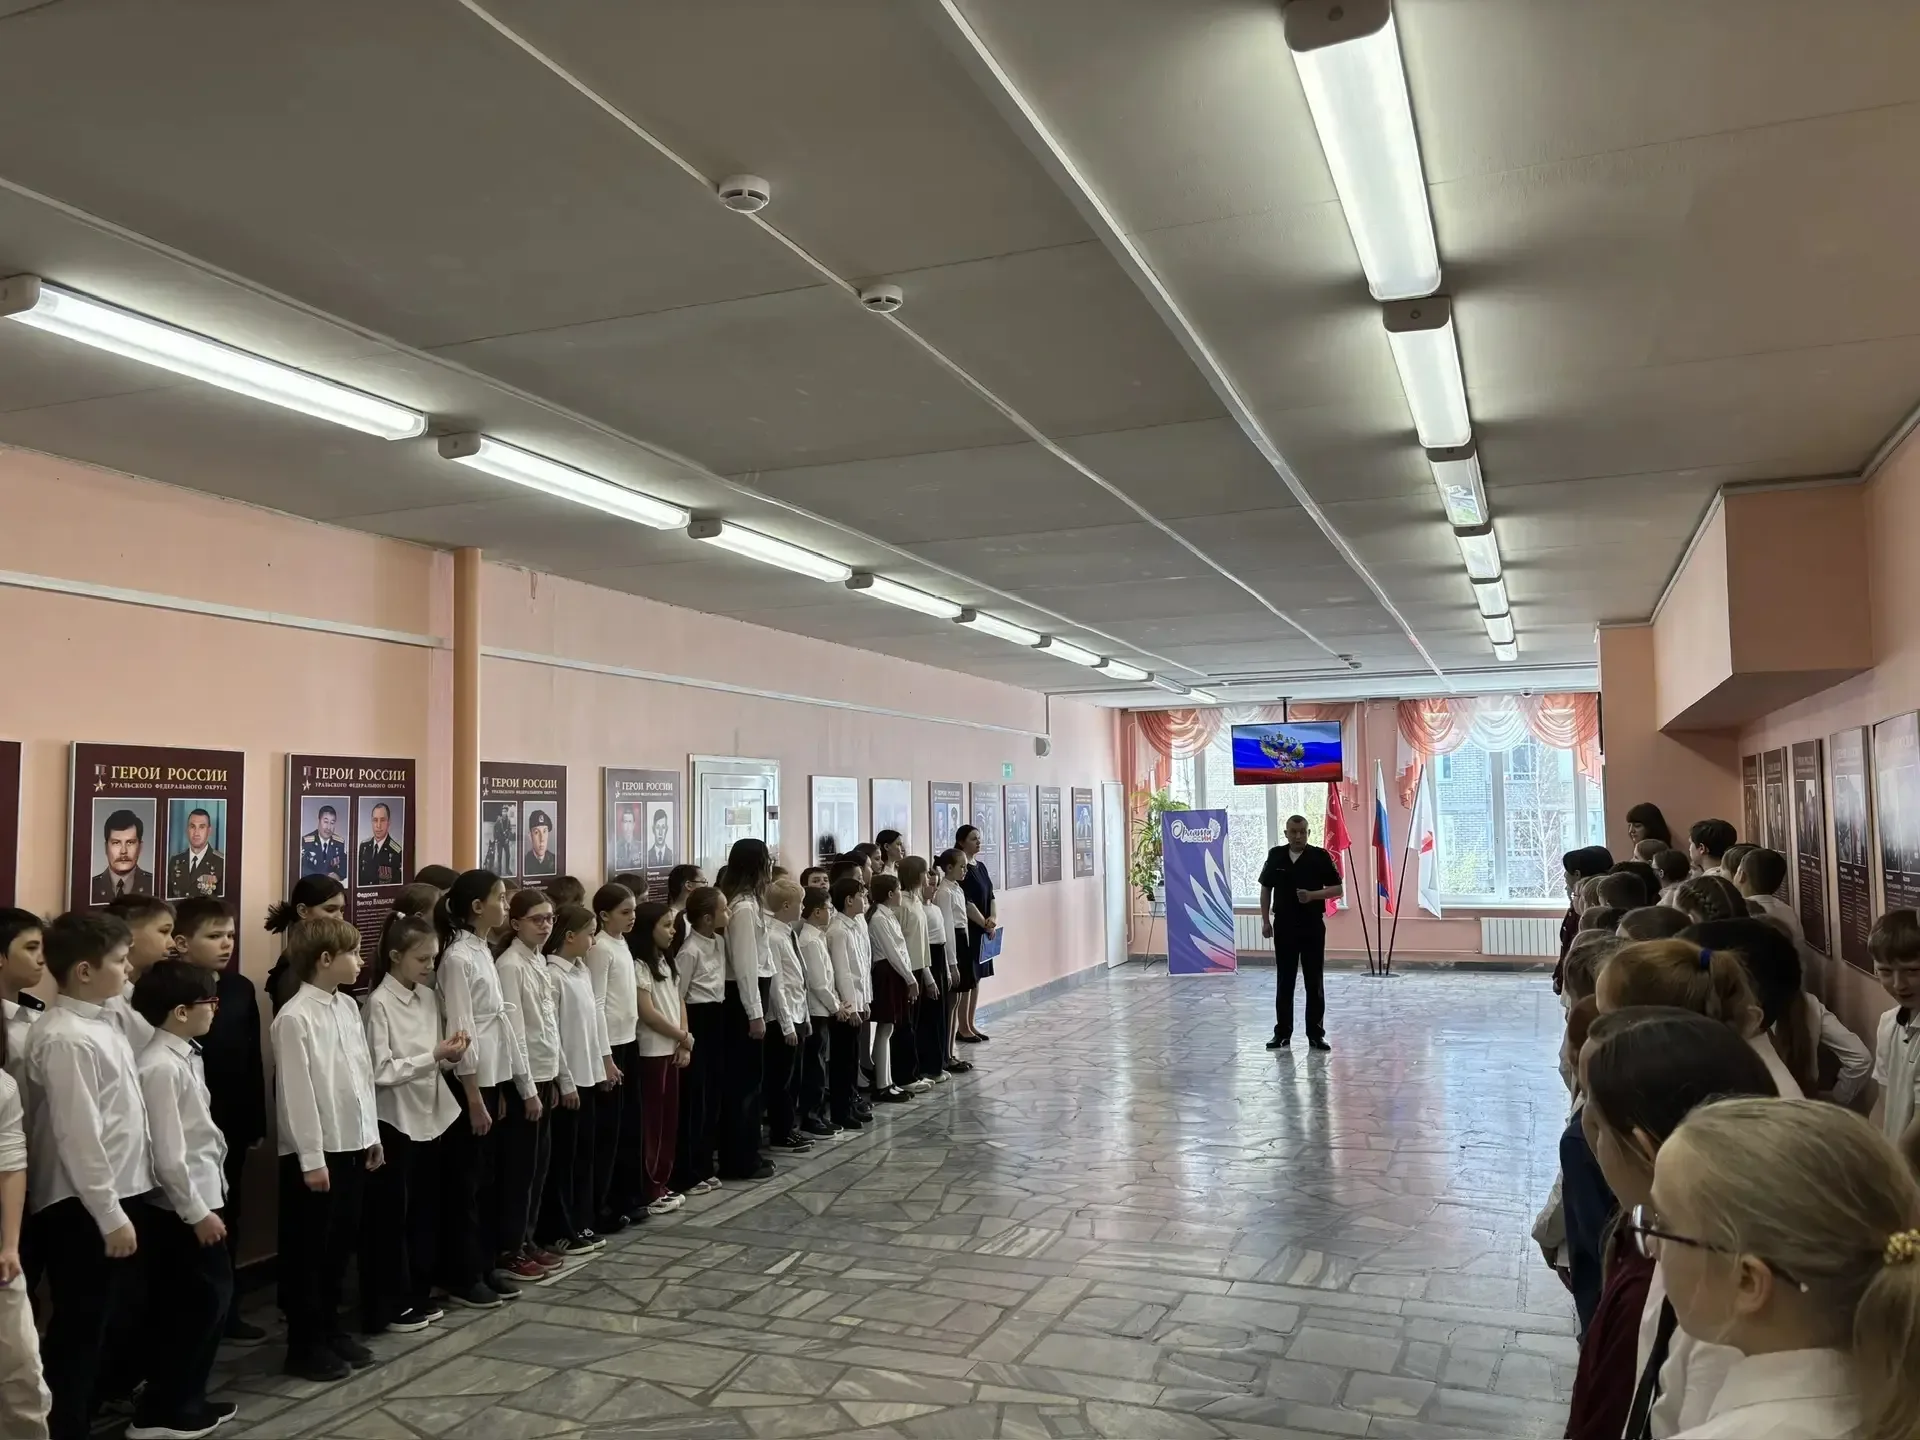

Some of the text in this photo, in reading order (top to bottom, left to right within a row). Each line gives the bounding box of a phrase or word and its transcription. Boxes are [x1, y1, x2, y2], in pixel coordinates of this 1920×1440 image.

[111, 766, 227, 781] ГЕРОИ РОССИИ
[315, 767, 406, 781] ГЕРОИ РОССИИ
[491, 777, 557, 789] ГЕРОИ РОССИИ
